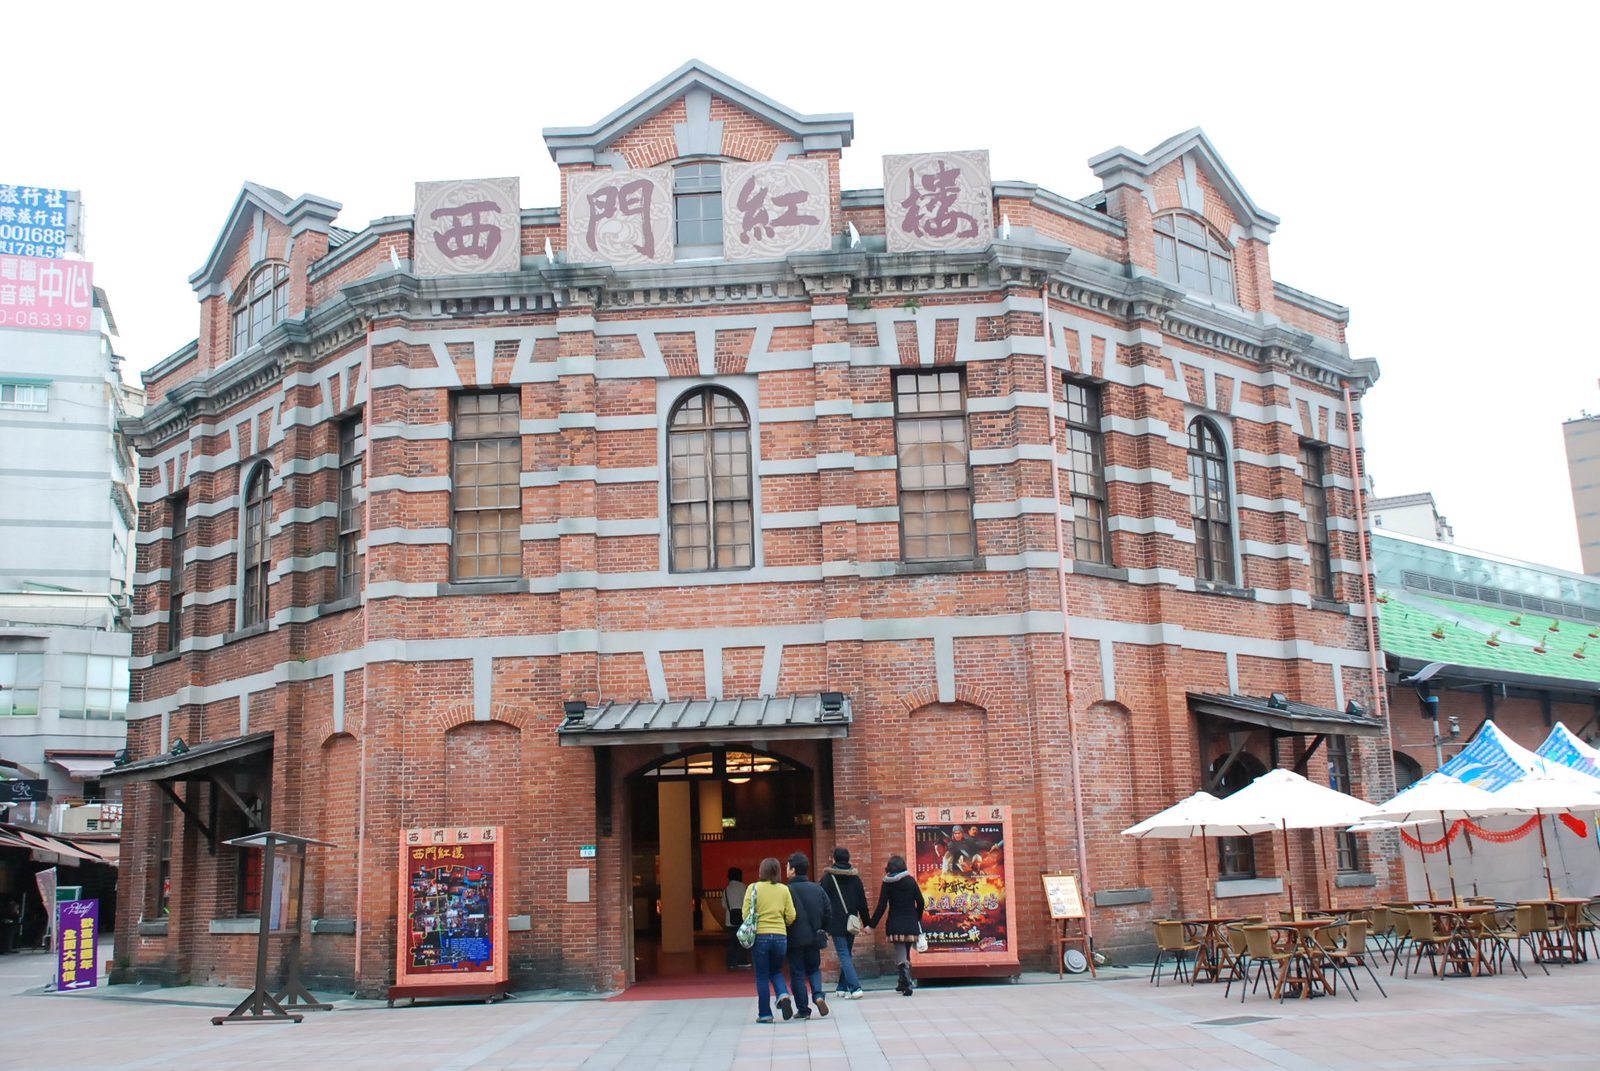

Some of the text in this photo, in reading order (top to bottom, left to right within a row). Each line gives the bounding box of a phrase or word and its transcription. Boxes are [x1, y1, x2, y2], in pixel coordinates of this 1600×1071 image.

[0, 184, 65, 208] 旅行社
[0, 224, 65, 245] 001688
[40, 261, 89, 308] 中心
